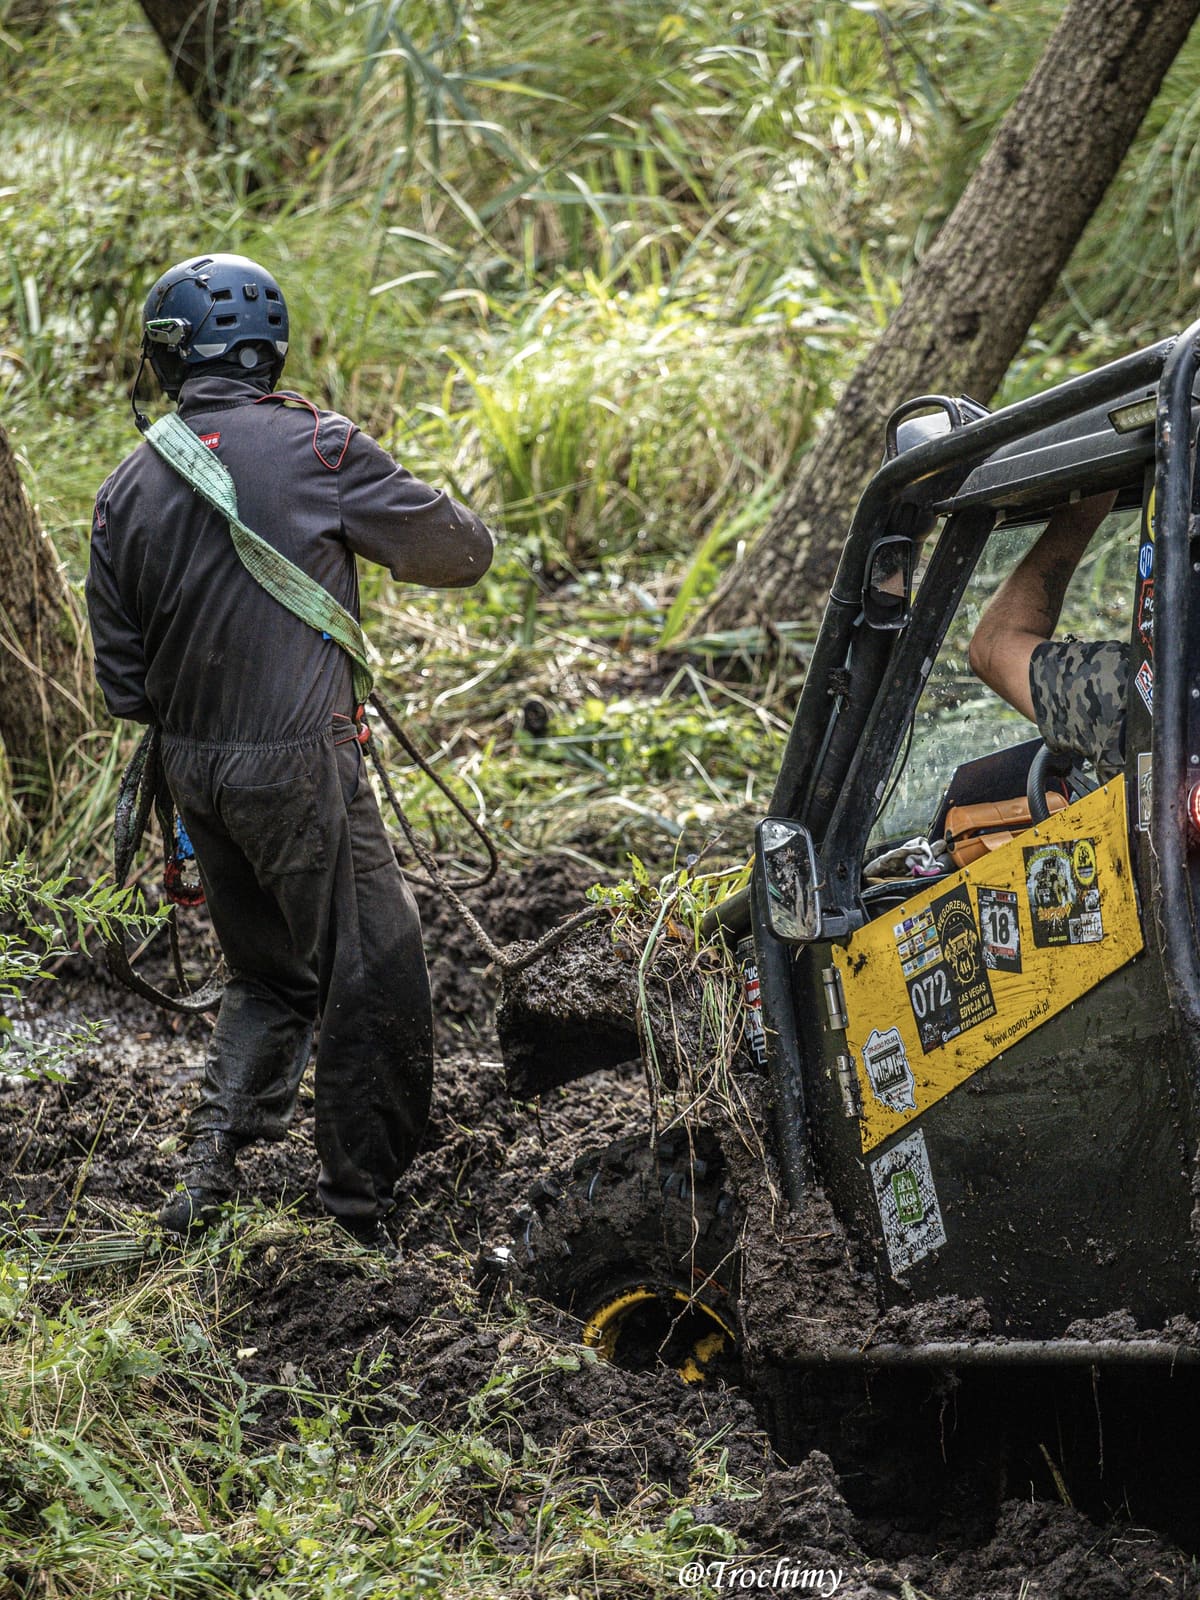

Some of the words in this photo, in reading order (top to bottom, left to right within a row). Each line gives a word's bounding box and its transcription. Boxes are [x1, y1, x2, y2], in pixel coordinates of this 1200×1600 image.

[988, 911, 1010, 945] 18
[911, 969, 951, 1018] 072
[958, 990, 970, 1005] LAS
[968, 981, 986, 1001] VEGAS
[959, 1000, 982, 1019] EDYCJA
[990, 999, 1050, 1048] www.opony-4x4.pl
